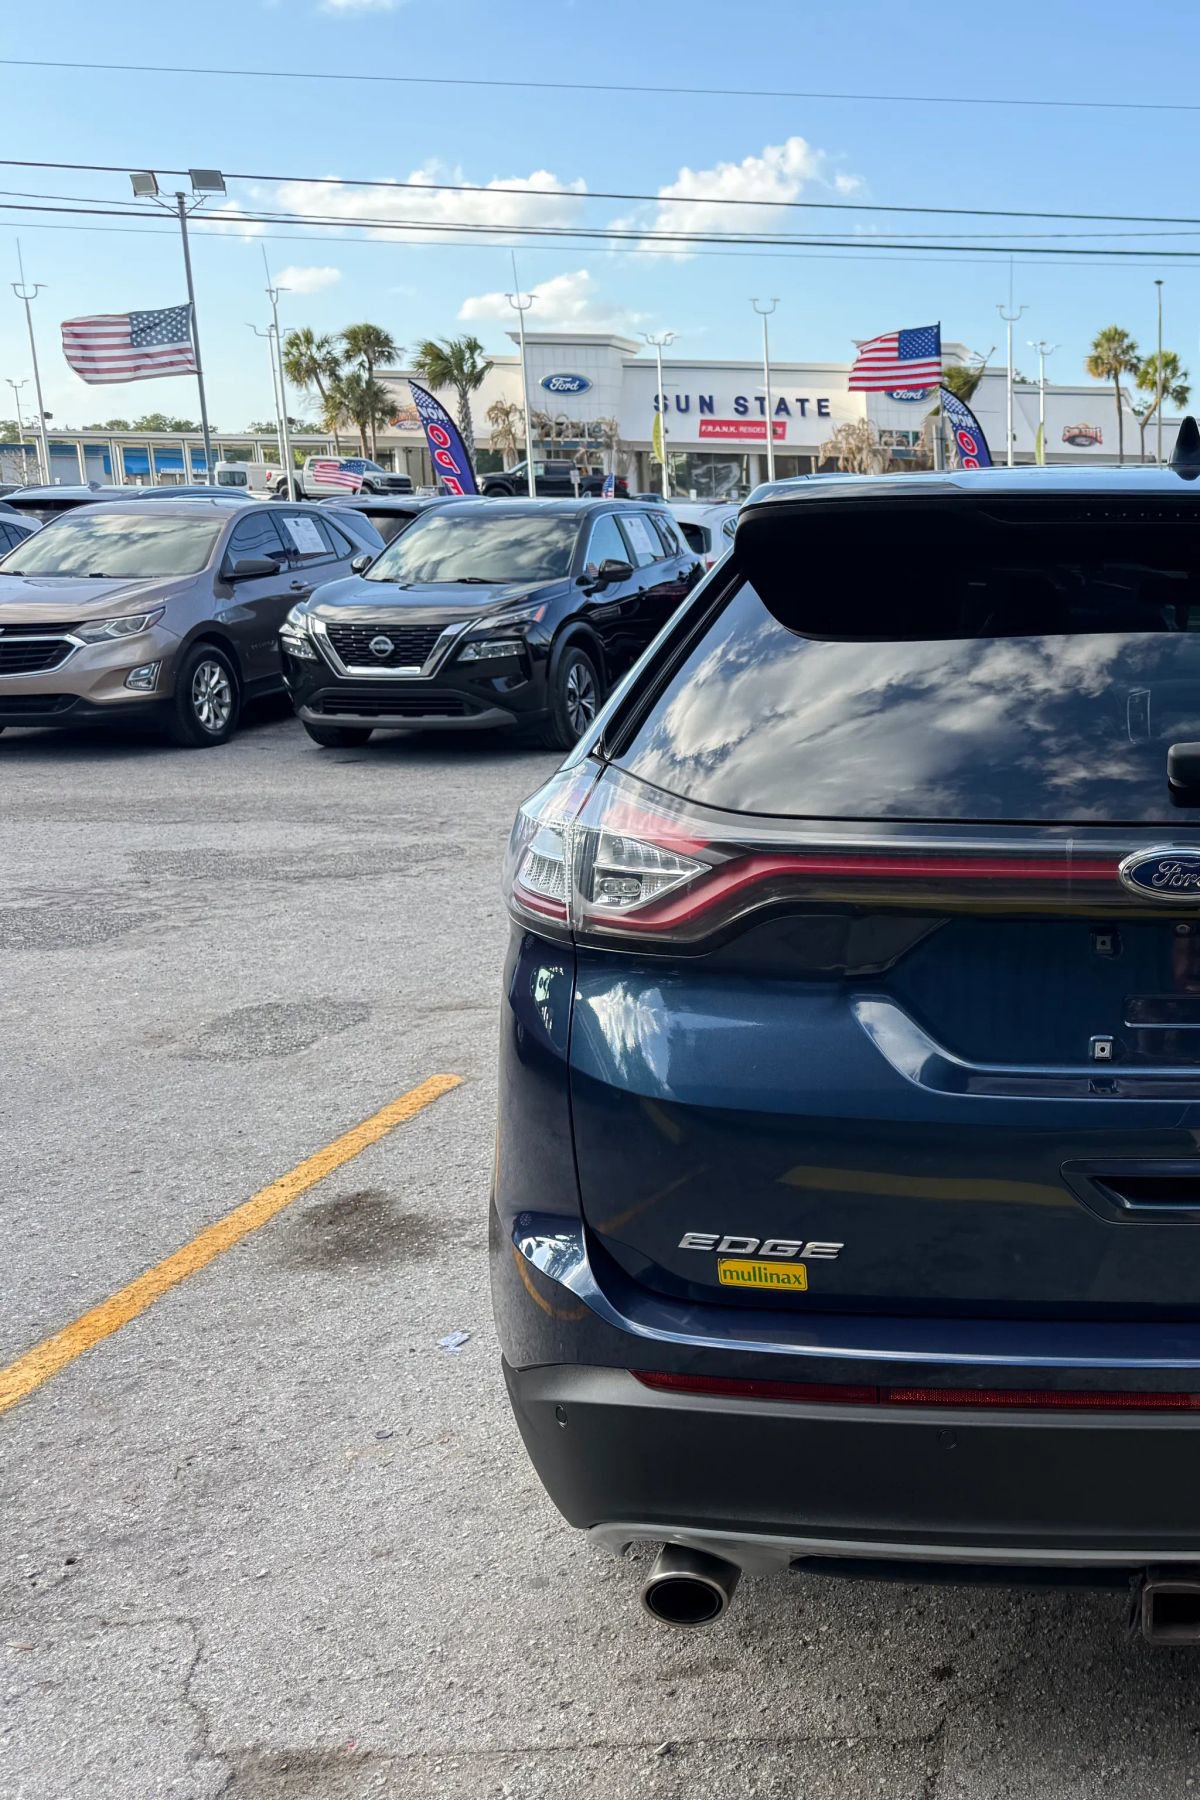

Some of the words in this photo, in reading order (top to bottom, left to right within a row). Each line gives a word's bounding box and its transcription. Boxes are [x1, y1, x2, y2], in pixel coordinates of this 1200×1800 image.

[653, 394, 714, 414] SUN
[733, 395, 831, 418] STATE
[678, 1232, 845, 1260] EDGE
[722, 1266, 803, 1285] mullinax
